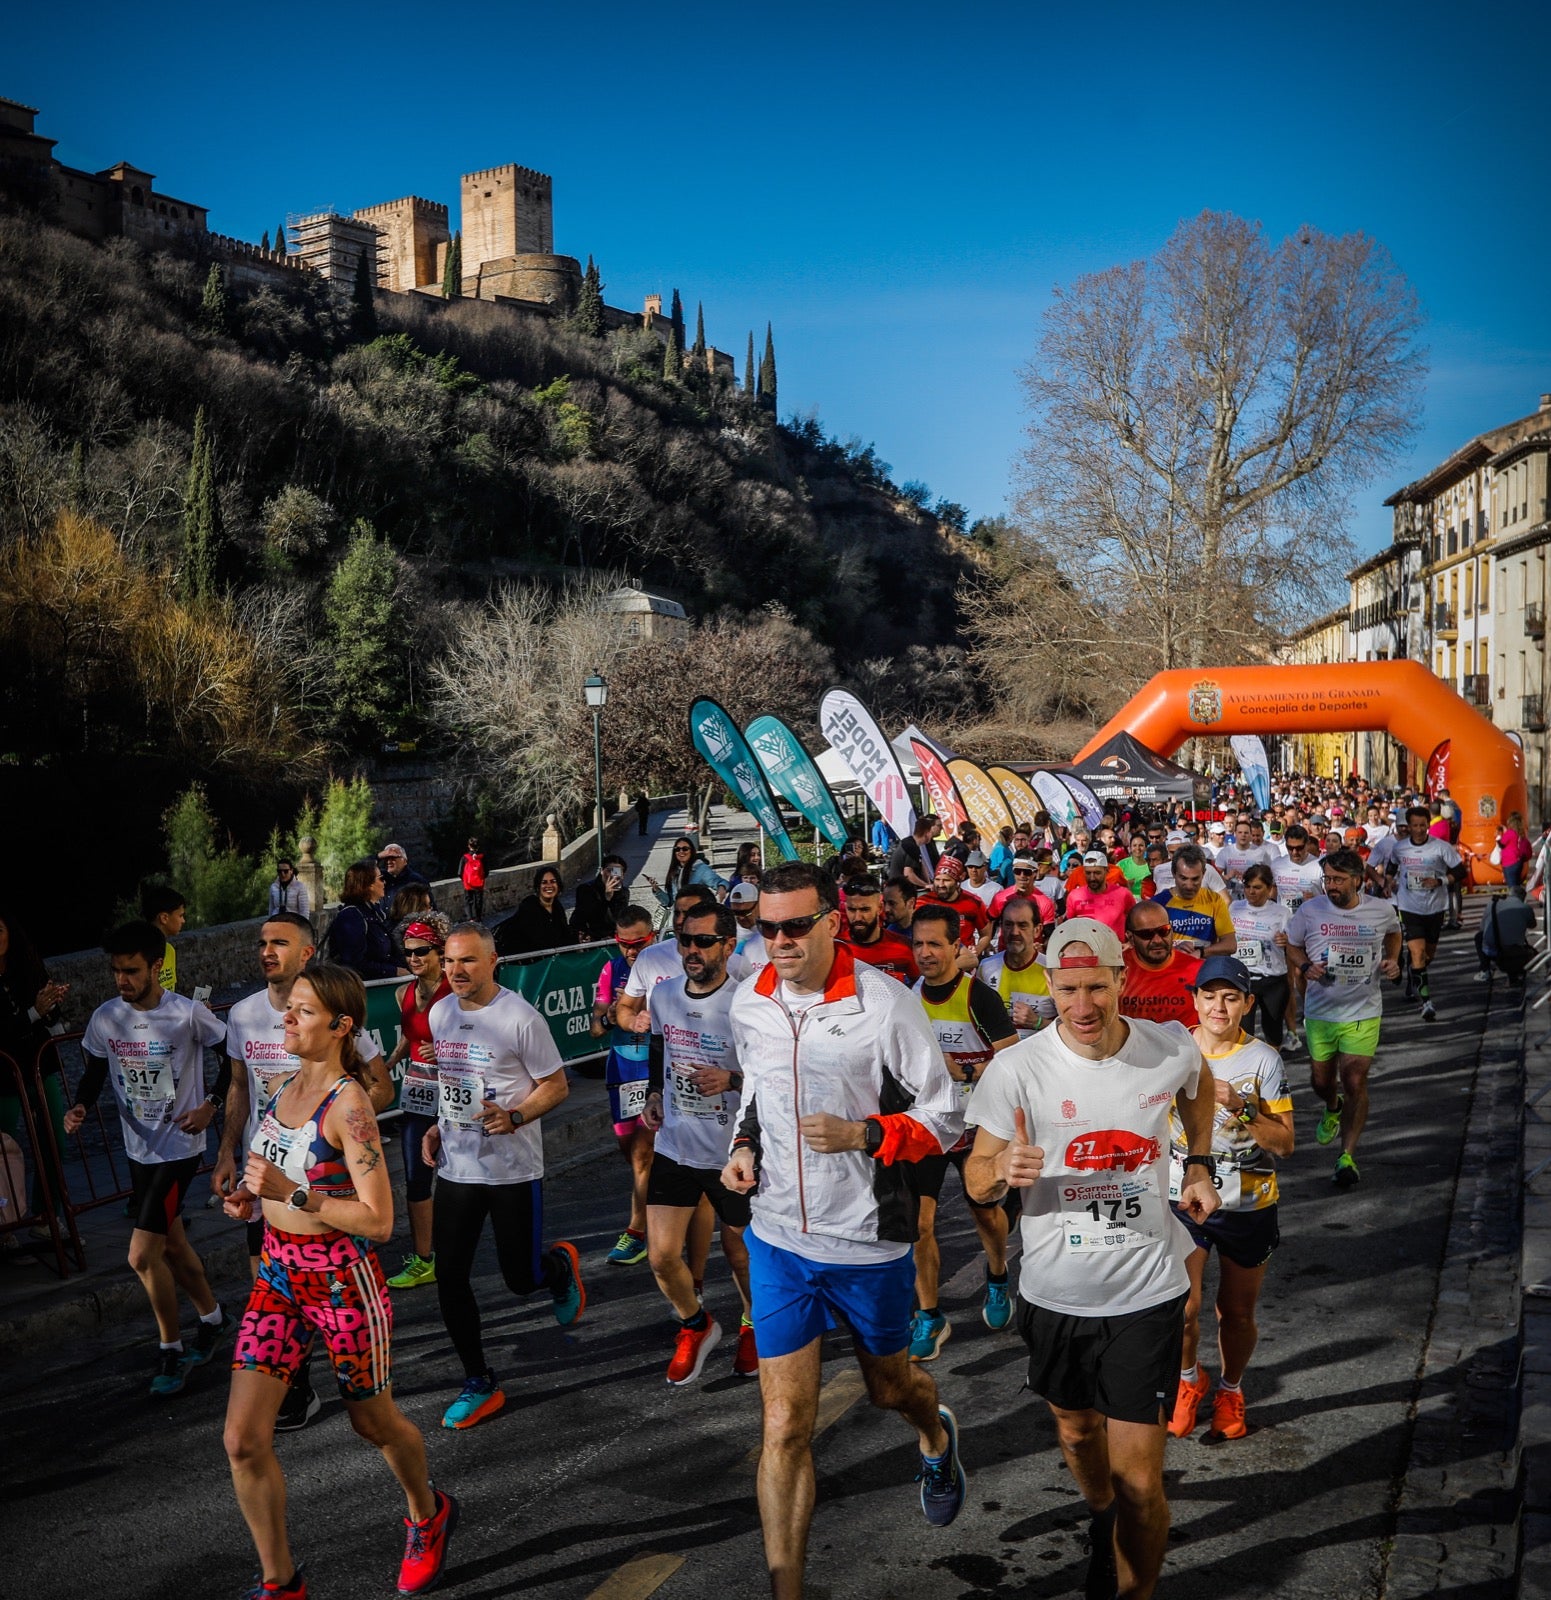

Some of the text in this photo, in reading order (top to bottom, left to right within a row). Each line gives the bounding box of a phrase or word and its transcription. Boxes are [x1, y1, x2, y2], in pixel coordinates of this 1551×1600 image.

[1302, 703, 1315, 712] de
[1319, 701, 1368, 713] Deportes
[1320, 923, 1328, 936] 9
[1238, 947, 1254, 957] 139
[1331, 944, 1337, 952] 9
[1339, 954, 1364, 964] 140
[544, 985, 586, 1016] CAJA
[1122, 995, 1186, 1008] agustinos
[567, 1013, 593, 1035] GRA
[663, 1023, 699, 1041] 9 Carrera
[108, 1038, 146, 1053] 9 Carrera
[245, 1040, 253, 1059] 9
[434, 1040, 468, 1057] 9 Carrera
[669, 1036, 700, 1049] Solidaria
[116, 1049, 148, 1057] Solidaria
[252, 1050, 288, 1060] Solidaria
[439, 1050, 468, 1060] Solidaria
[129, 1069, 160, 1084] 317
[675, 1076, 701, 1094] 53
[408, 1086, 434, 1102] 448
[444, 1086, 471, 1105] 333
[262, 1139, 289, 1166] 197
[1072, 1140, 1096, 1156] 27
[1063, 1184, 1118, 1201] 9 Carrera
[1077, 1191, 1122, 1200] Solidaria
[1123, 1187, 1149, 1197] Granada
[1086, 1196, 1142, 1221] 175
[1106, 1221, 1127, 1229] JOHN
